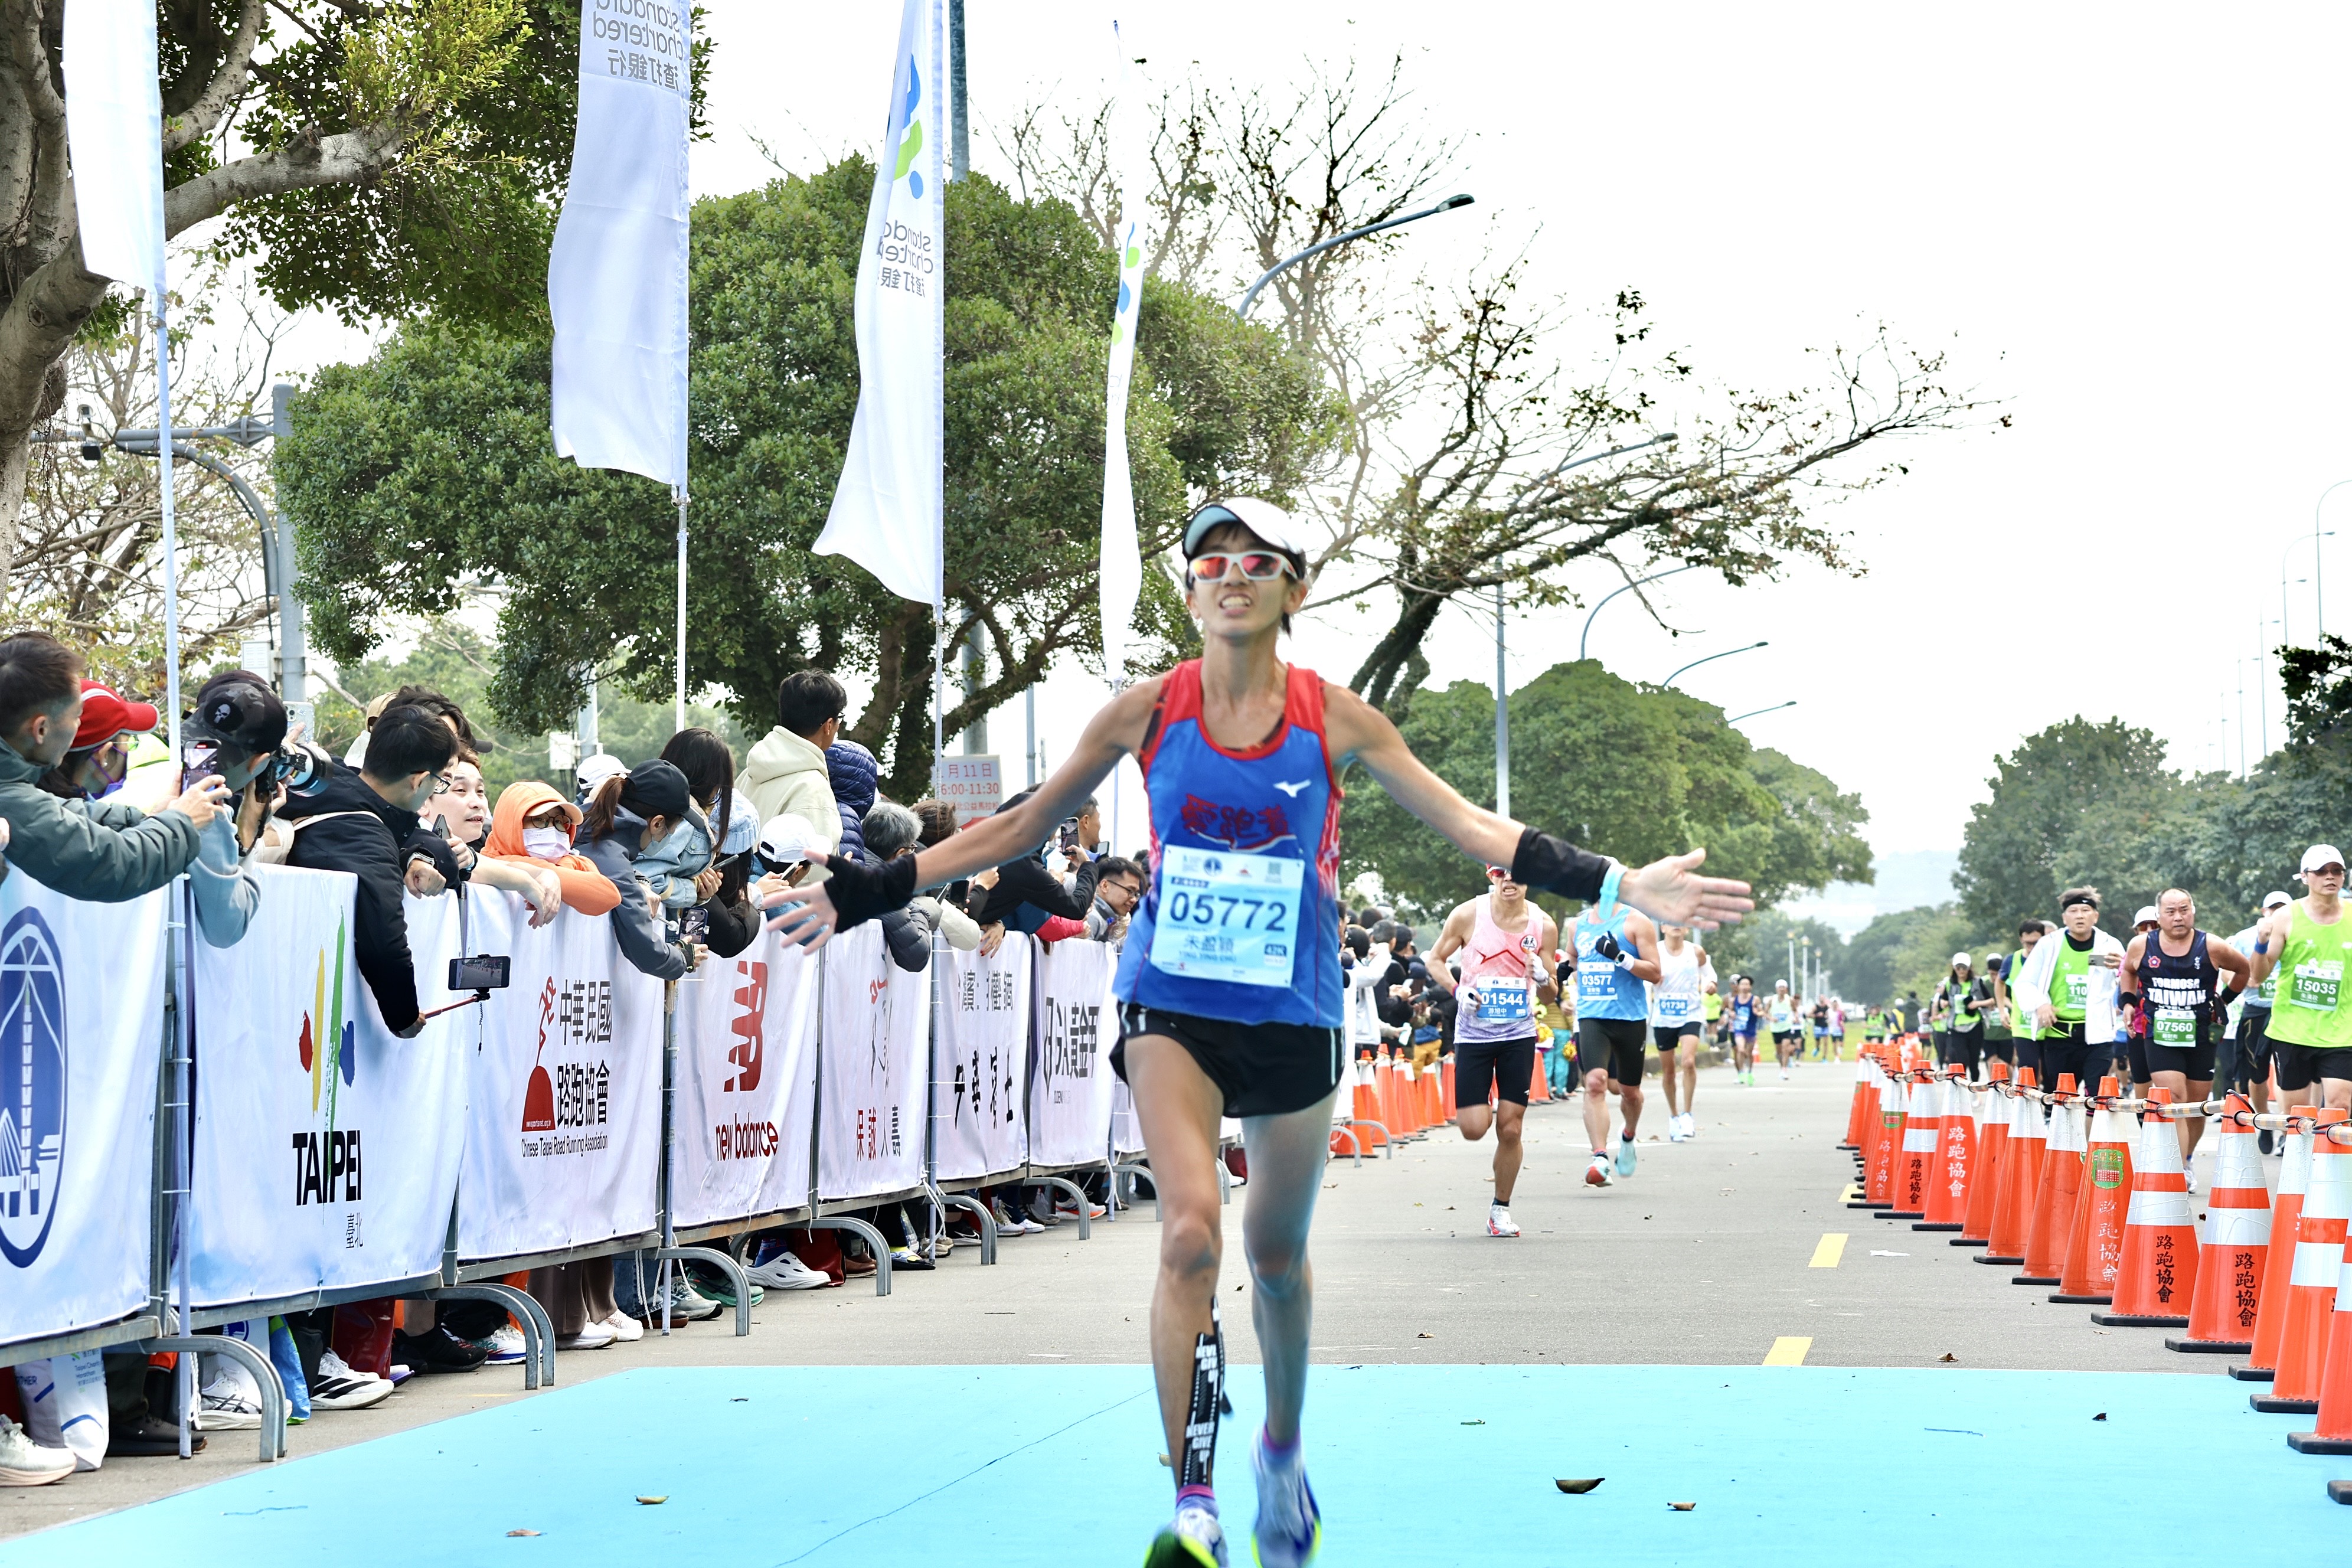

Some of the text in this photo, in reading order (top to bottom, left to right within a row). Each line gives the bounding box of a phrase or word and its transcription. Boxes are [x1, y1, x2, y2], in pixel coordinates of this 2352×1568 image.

[1170, 891, 1287, 932] 05772
[1582, 975, 1612, 985] 03577
[2069, 985, 2087, 996] 110
[2151, 977, 2200, 989] FORMOSA
[2261, 982, 2276, 990] 104
[2296, 978, 2337, 995] 15035
[1481, 992, 1524, 1006] 01544
[2147, 988, 2206, 1006] TAIWAN
[560, 979, 612, 1046] 中華民國
[2157, 1021, 2193, 1033] 07560
[557, 1059, 610, 1129] 路跑協會
[521, 1131, 608, 1161] Chinese Taipei Road Running Association
[716, 1112, 779, 1162] new balance
[292, 1129, 362, 1206] TAIPEI
[1947, 1126, 1967, 1197] 路跑協會
[1909, 1158, 1923, 1204] 路跑協會
[2155, 1234, 2175, 1304] 路跑協會
[2235, 1252, 2257, 1327] 路跑協會
[1186, 1421, 1216, 1439] NEVER
